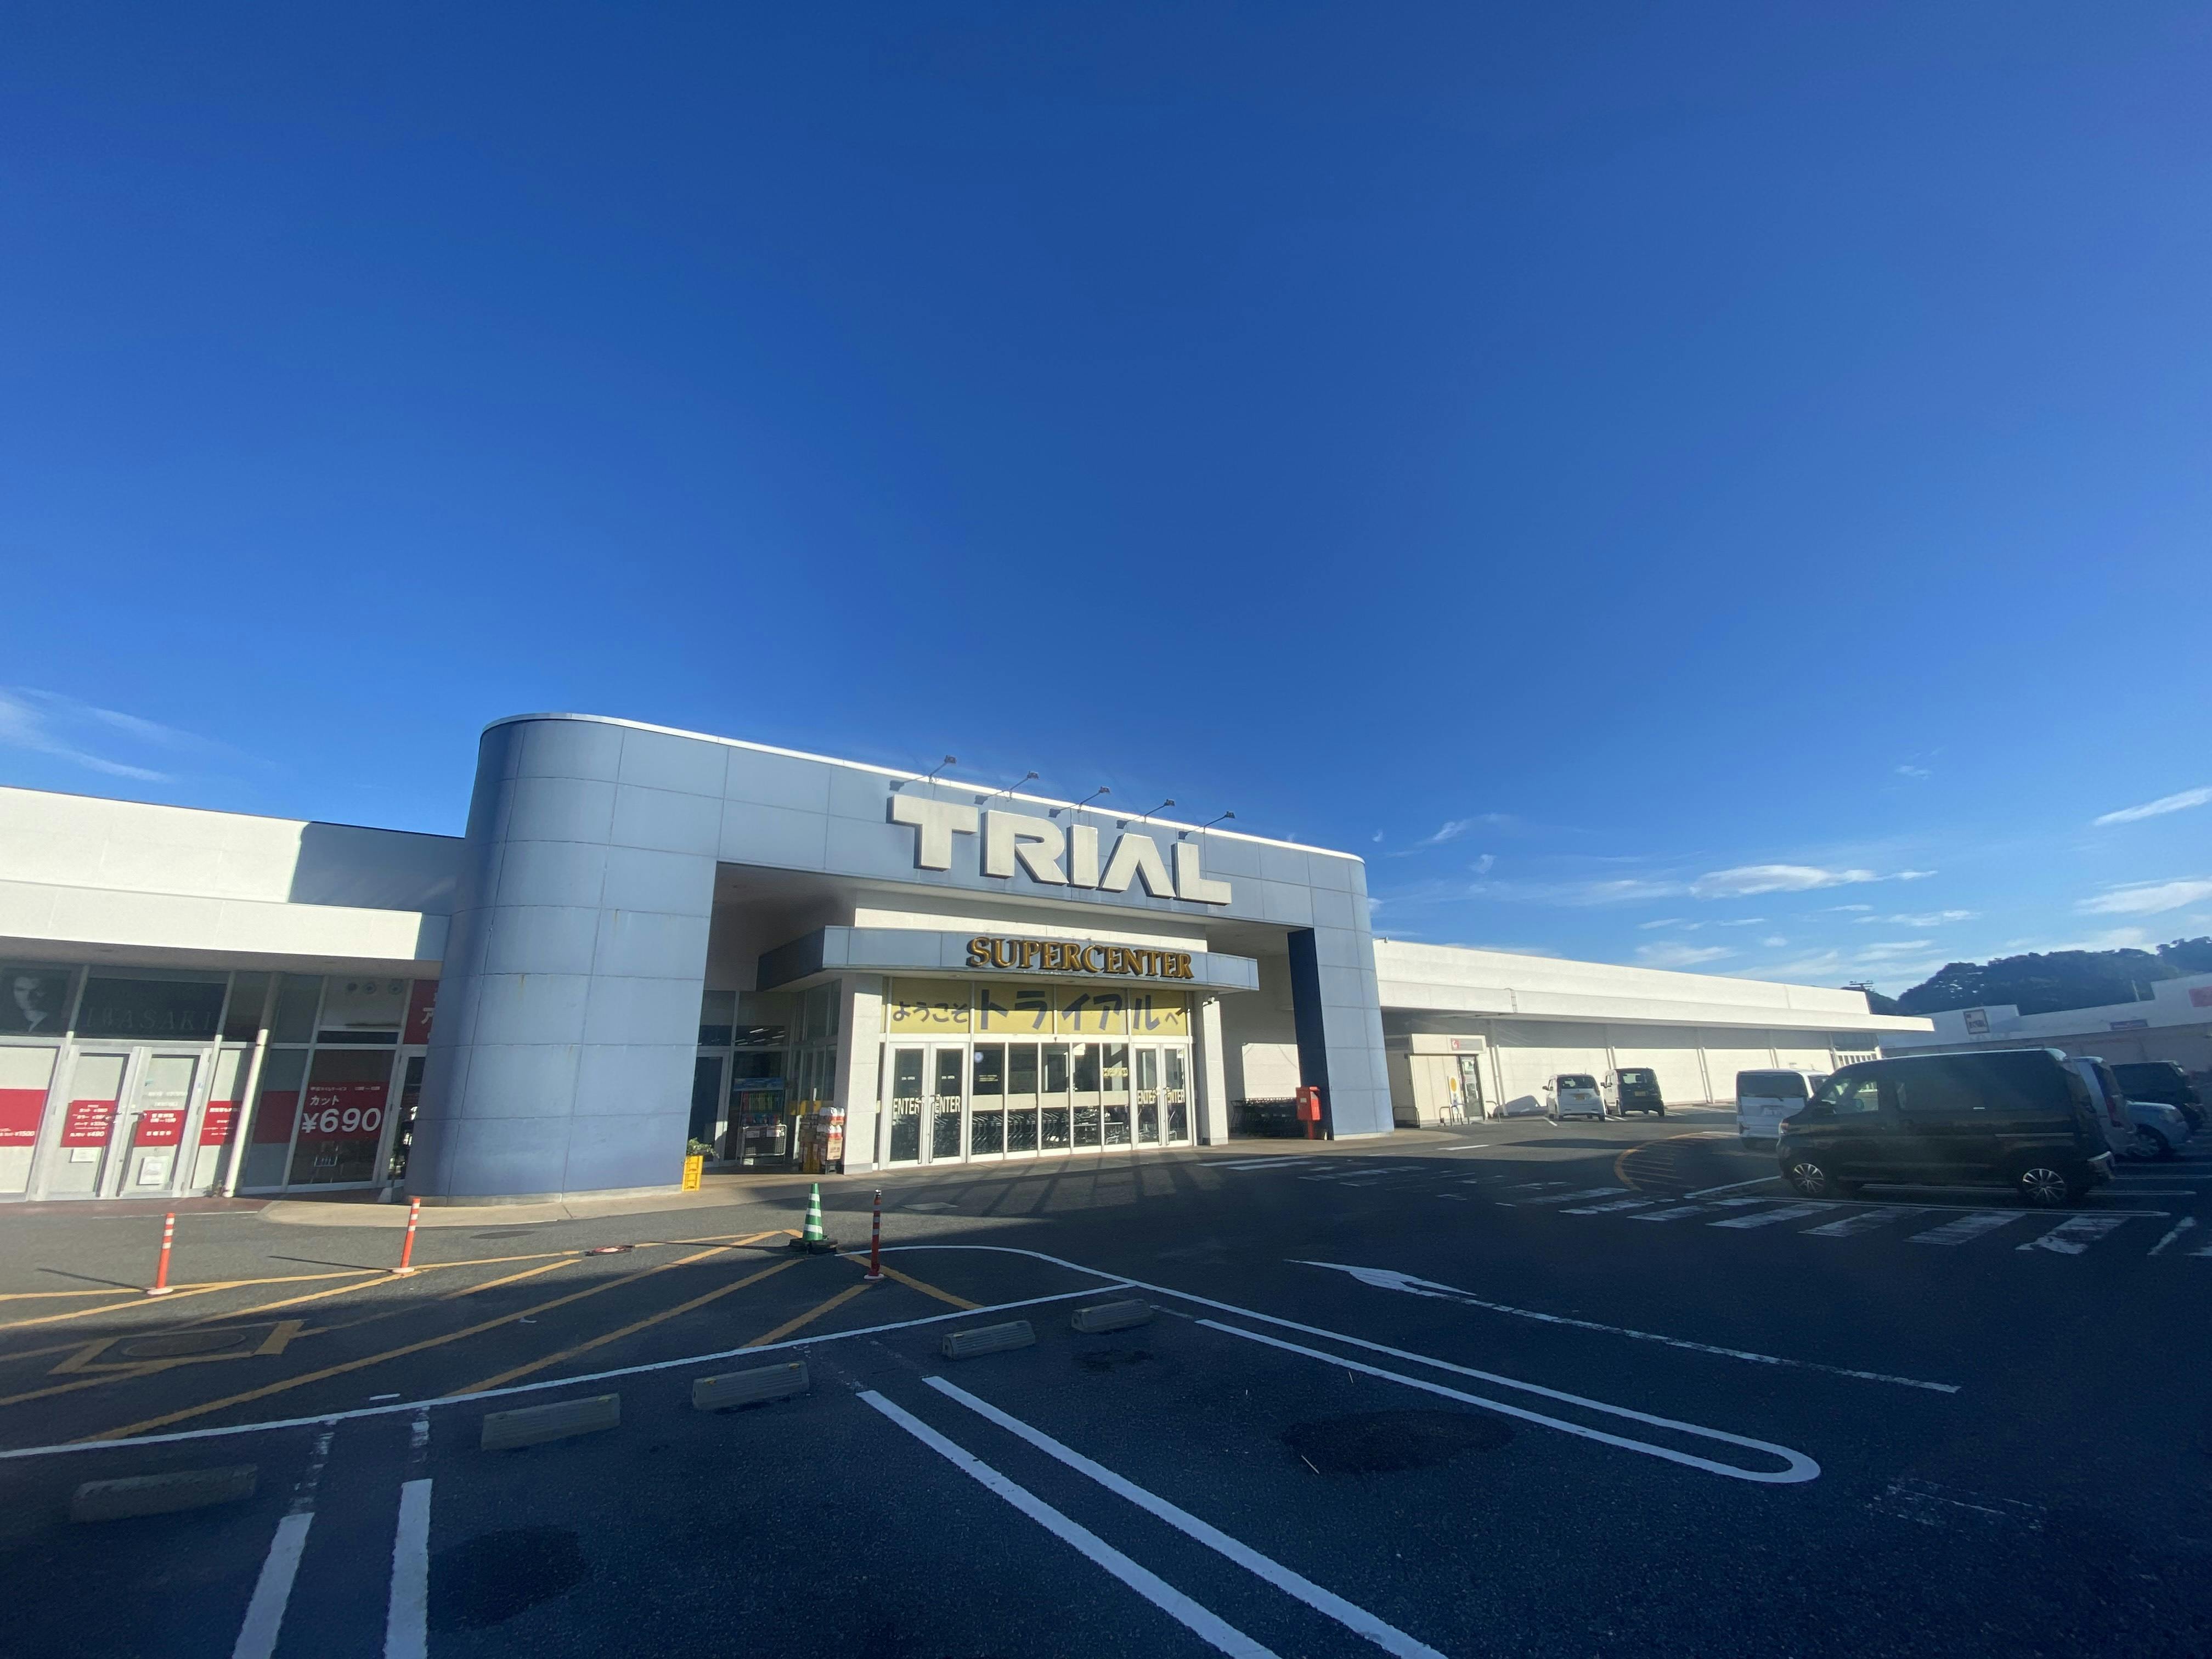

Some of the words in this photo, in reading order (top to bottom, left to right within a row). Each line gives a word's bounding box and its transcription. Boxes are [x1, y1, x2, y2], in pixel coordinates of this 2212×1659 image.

[887, 794, 1232, 906] TRIAL
[966, 936, 1194, 979] SUPERCENTER
[310, 1095, 339, 1105] カット
[893, 1097, 920, 1115] ENTER
[935, 1096, 960, 1113] ENTER
[302, 1107, 381, 1133] ¥690
